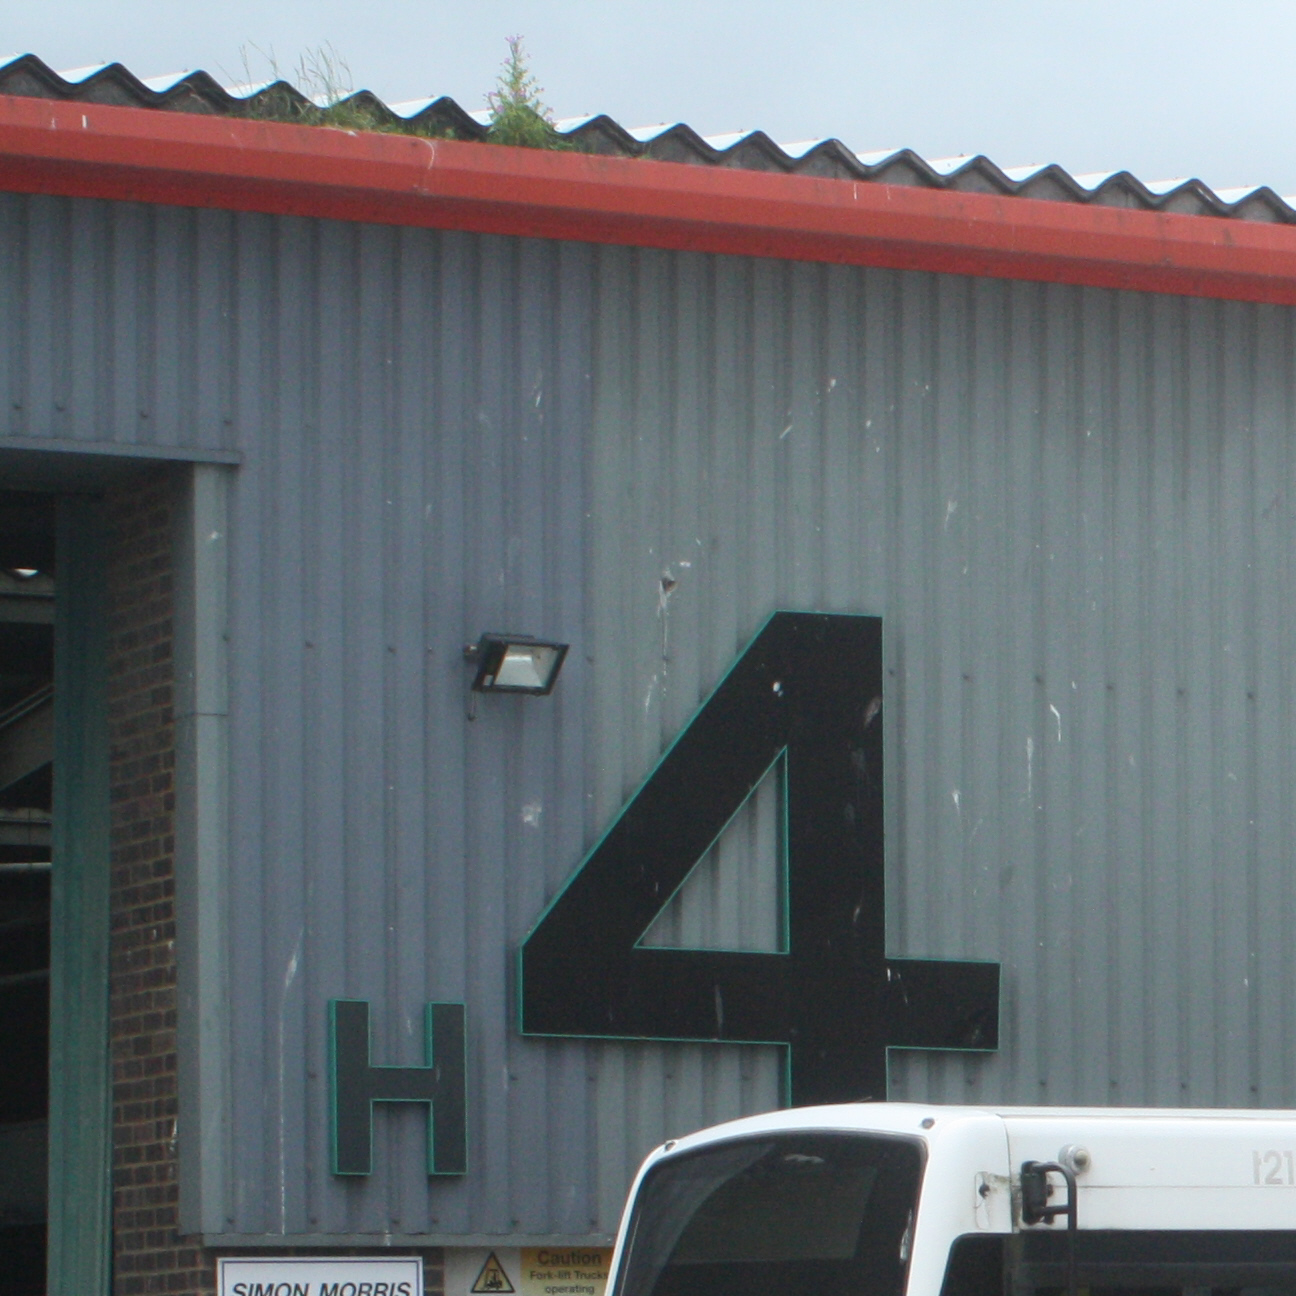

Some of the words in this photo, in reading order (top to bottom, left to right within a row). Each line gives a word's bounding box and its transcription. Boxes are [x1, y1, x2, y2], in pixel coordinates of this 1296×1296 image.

[329, 999, 468, 1177] H
[519, 610, 1002, 1108] 4
[537, 1250, 602, 1266] Caution
[544, 1285, 596, 1296] operating
